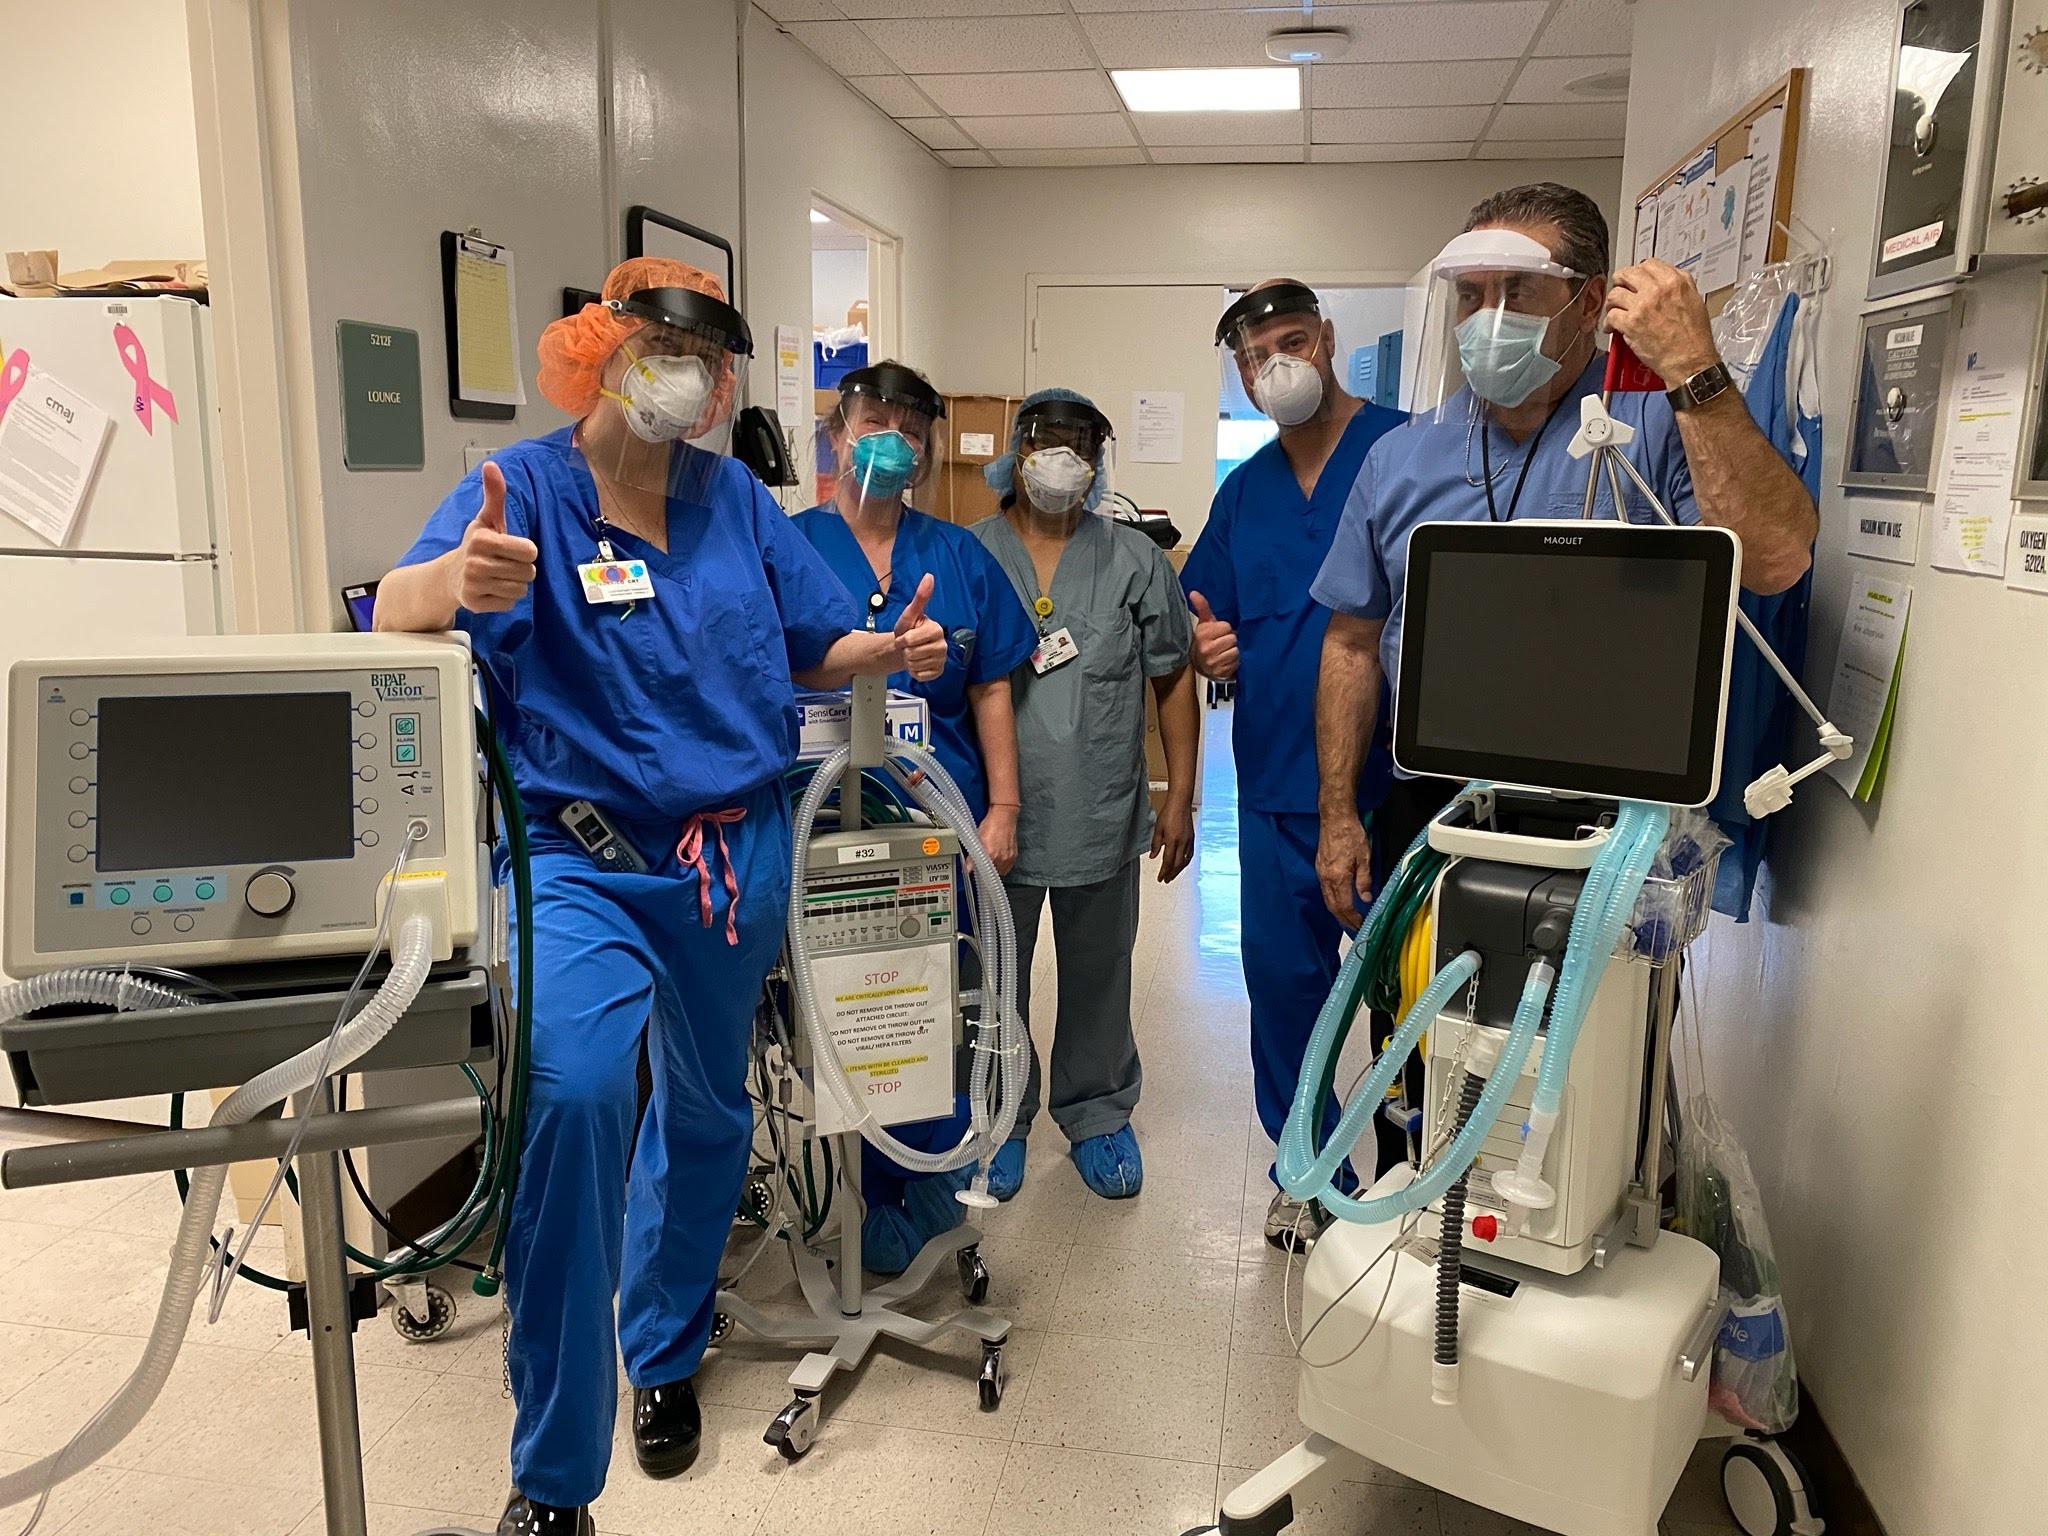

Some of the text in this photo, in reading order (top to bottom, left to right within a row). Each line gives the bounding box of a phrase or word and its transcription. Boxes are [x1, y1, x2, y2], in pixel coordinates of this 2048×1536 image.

[1885, 228, 1940, 254] MEDICAL AIR
[370, 333, 392, 347] 5212F
[368, 390, 401, 404] LOUNGE
[46, 396, 76, 424] cmaj
[1892, 523, 1902, 538] USE
[2020, 530, 2048, 550] OXYGEN
[371, 673, 406, 687] BiPAP
[375, 685, 422, 702] Vision
[808, 708, 847, 718] SensiCare
[904, 725, 919, 741] M
[855, 848, 875, 858] #32
[926, 863, 950, 871] VIASYS
[864, 970, 899, 986] STOP
[855, 992, 883, 1000] CRITICALLY
[905, 985, 929, 994] SUPPLIES
[859, 1006, 884, 1014] REMOVE
[894, 1002, 915, 1010] THROW
[855, 1014, 885, 1023] ATTACHED
[853, 1025, 877, 1034] REMOVE
[887, 1021, 909, 1029] THROW
[860, 1035, 885, 1043] REMOVE
[895, 1030, 916, 1038] THROW
[855, 1039, 912, 1052] VIRAL/ HEPA FILTERS
[849, 1065, 867, 1073] ITEMS
[867, 1062, 883, 1070] WITH
[891, 1057, 916, 1066] CLEANED
[916, 1055, 929, 1063] AND
[869, 1067, 899, 1078] STERILIZED
[867, 1080, 902, 1096] STOP
